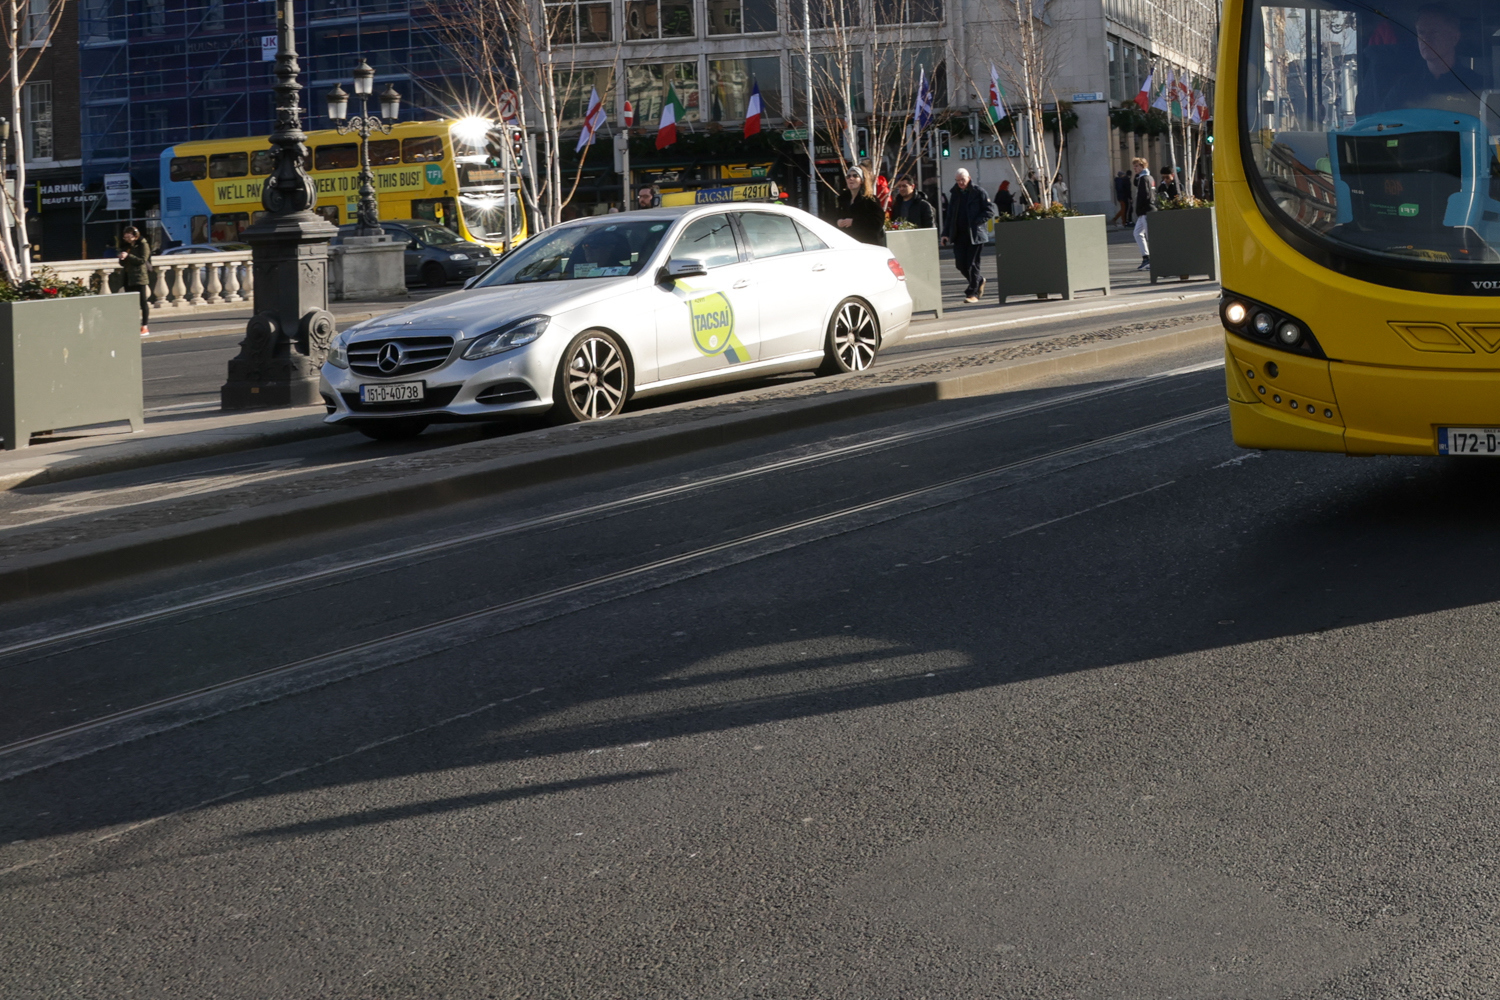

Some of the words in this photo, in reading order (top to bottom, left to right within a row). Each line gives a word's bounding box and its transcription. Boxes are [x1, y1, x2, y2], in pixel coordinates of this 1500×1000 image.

[263, 37, 276, 47] JK
[426, 170, 442, 180] TFI
[246, 181, 261, 198] PAY
[337, 176, 348, 191] TO
[378, 173, 397, 188] THIS
[742, 184, 768, 199] 42911
[42, 196, 71, 205] BEAUTY
[694, 306, 729, 332] TACSAÍ
[367, 385, 419, 401] 151-D-40738
